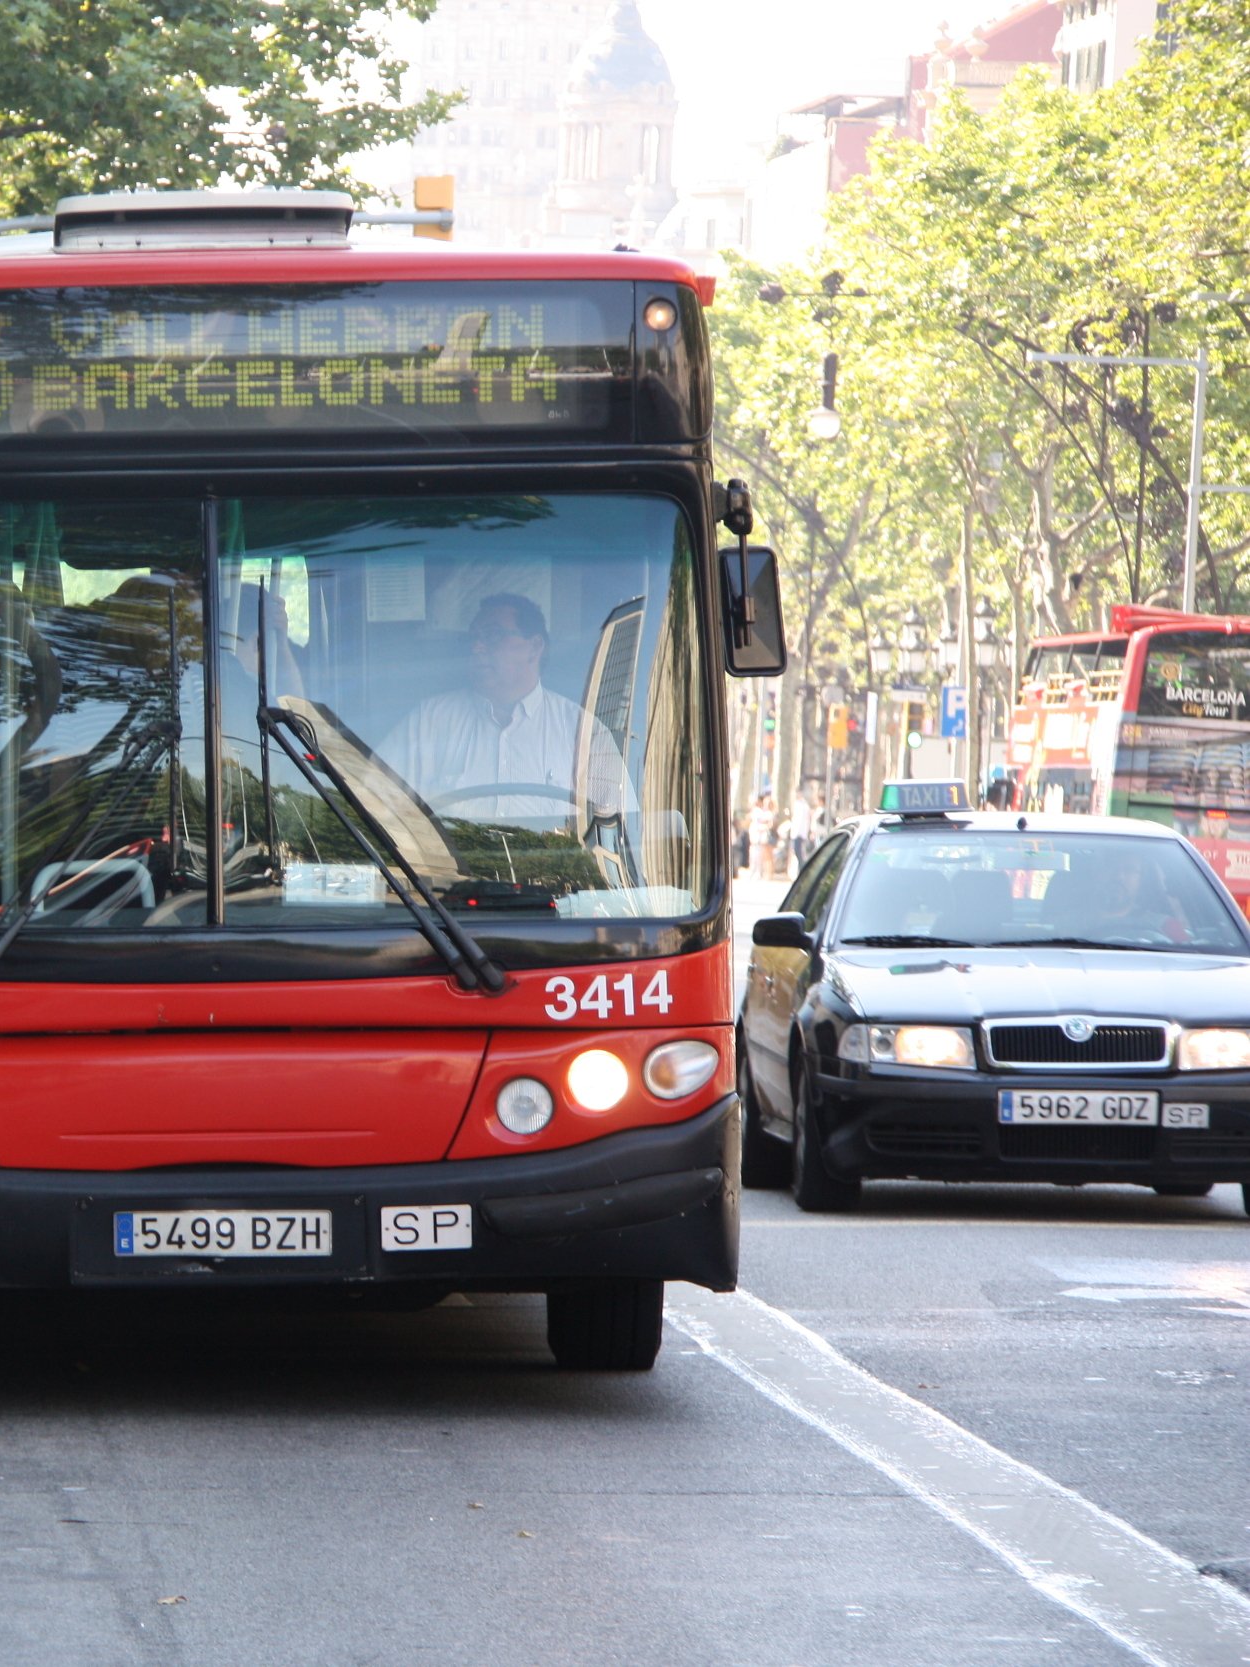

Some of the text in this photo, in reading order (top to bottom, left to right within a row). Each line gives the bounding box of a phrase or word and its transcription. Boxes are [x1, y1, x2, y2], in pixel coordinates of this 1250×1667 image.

[50, 310, 224, 359] VALL
[33, 354, 557, 411] BARCELONETA
[1166, 686, 1246, 706] BARCELONA
[902, 785, 940, 808] TAXI
[544, 969, 673, 1021] 3414
[1019, 1096, 1149, 1120] 5962 GDZ
[1168, 1106, 1204, 1124] SP
[141, 1217, 321, 1250] 5499 BZH
[393, 1210, 459, 1245] SP
